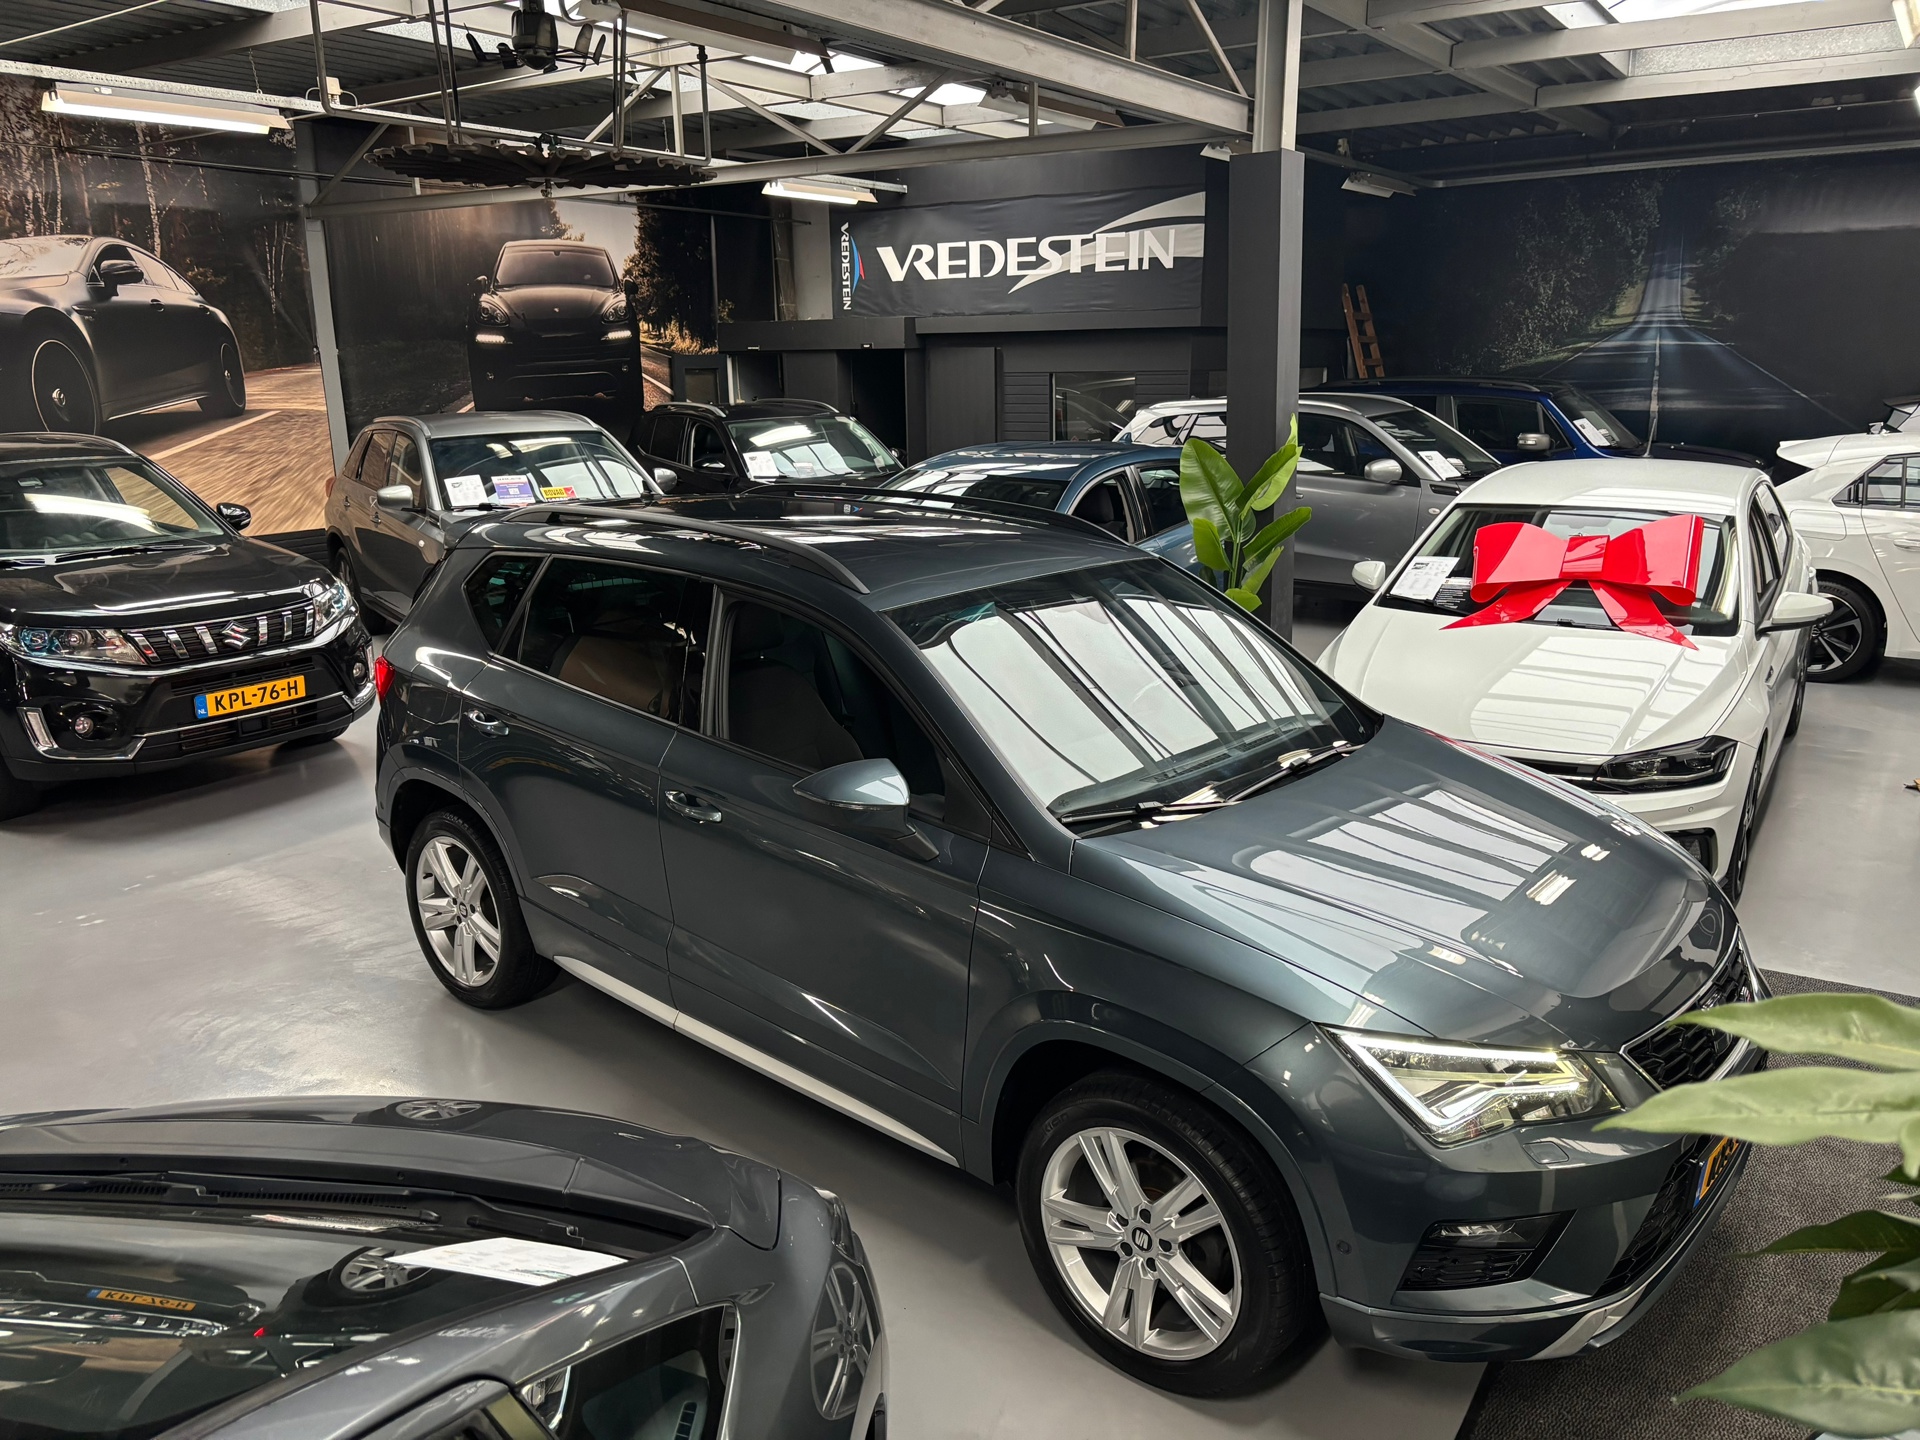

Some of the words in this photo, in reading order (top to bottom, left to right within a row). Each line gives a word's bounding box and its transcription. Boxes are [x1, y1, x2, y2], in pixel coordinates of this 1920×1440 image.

[841, 222, 852, 311] VREDESTEIN
[876, 228, 1175, 283] VREDESTEIN
[214, 680, 299, 712] KPL-76-H
